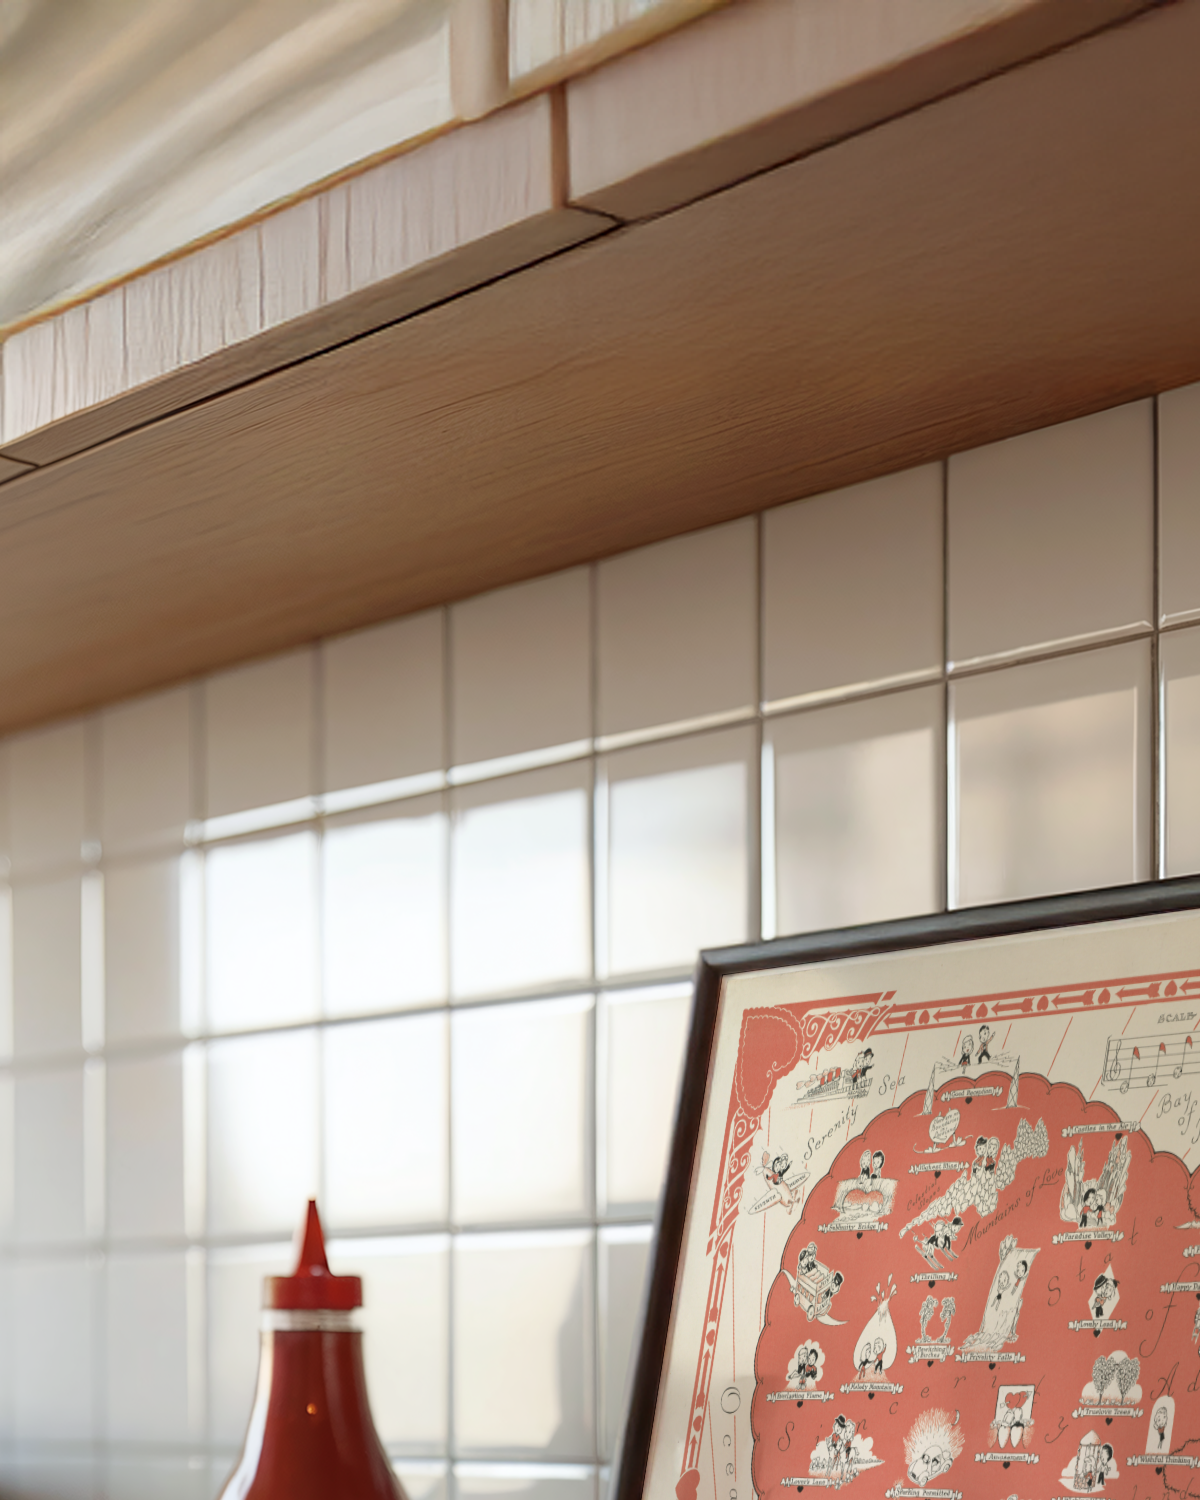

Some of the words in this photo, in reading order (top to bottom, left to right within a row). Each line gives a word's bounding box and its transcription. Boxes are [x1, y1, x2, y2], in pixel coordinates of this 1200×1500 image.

[1157, 1013, 1198, 1024] SCALE
[951, 1089, 964, 1097] Good
[966, 1087, 993, 1096] Reception
[1156, 1091, 1192, 1118] Bay
[804, 1105, 858, 1160] Serenity
[879, 1075, 905, 1095] Sea
[1178, 1100, 1198, 1135] of
[1073, 1125, 1096, 1133] Castles
[961, 1198, 1021, 1251] Mountains
[1025, 1175, 1040, 1206] of
[1039, 1167, 1065, 1189] Love
[1064, 1233, 1091, 1241] Paradise
[1093, 1231, 1113, 1240] Valley
[1047, 1215, 1164, 1307] State
[1139, 1262, 1200, 1358] of
[1172, 1283, 1191, 1291] Happy
